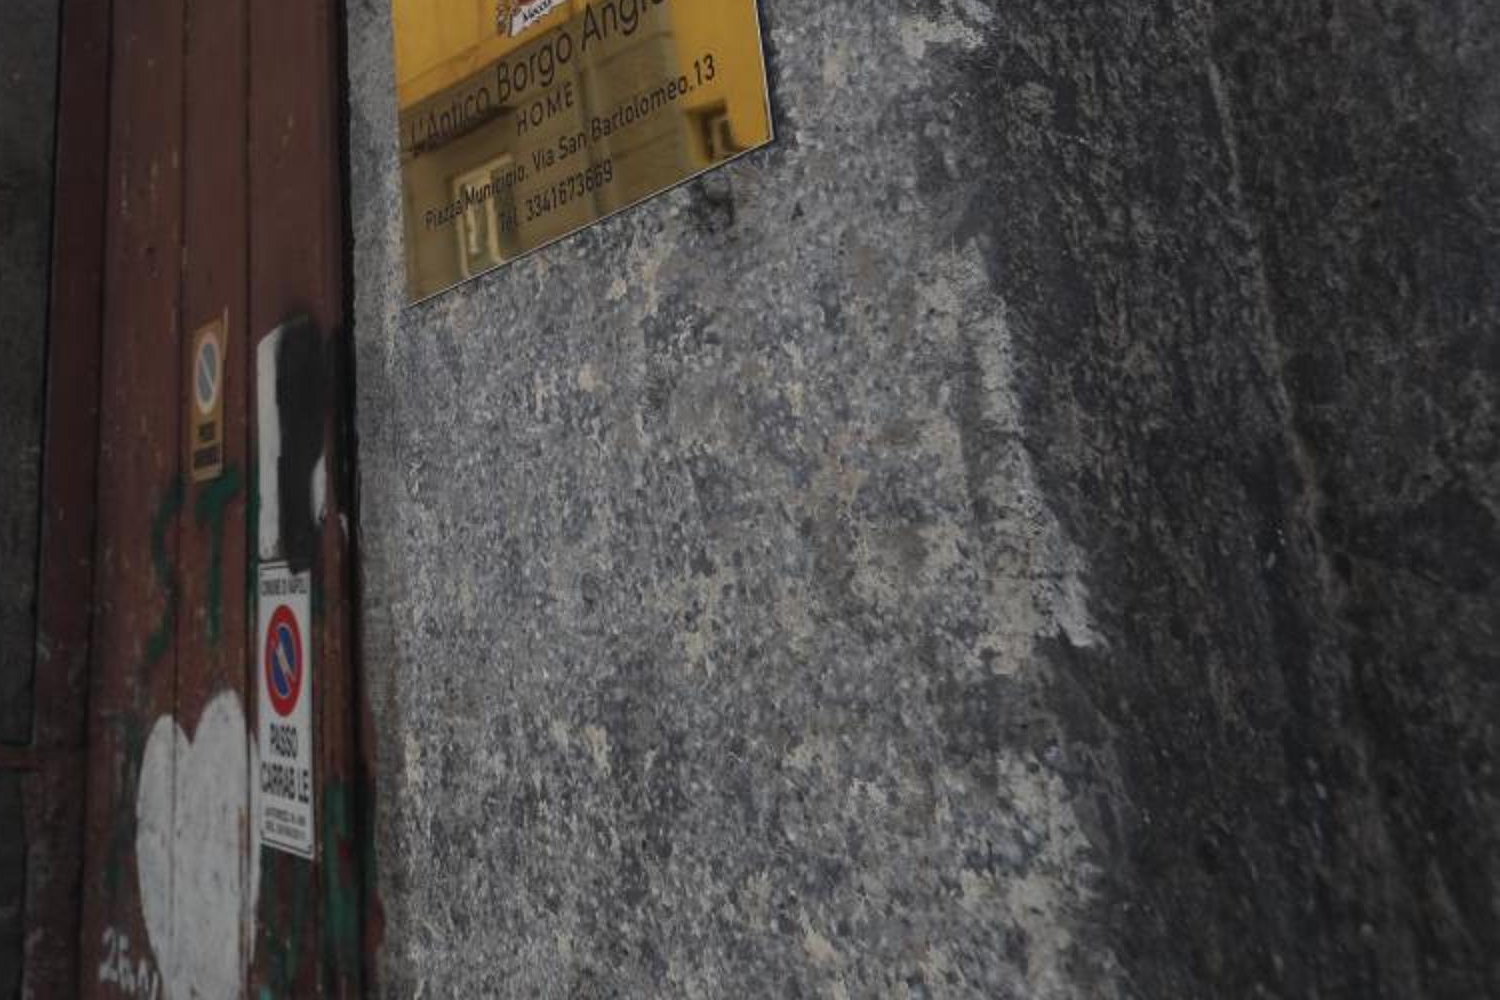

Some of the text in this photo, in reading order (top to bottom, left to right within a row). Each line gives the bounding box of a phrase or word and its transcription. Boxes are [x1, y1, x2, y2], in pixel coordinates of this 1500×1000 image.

[409, 86, 491, 158] L'Antico
[516, 80, 574, 137] HOME
[424, 198, 464, 231] Piazza
[532, 146, 556, 171] Via
[558, 132, 588, 160] San
[269, 723, 298, 758] PASSO
